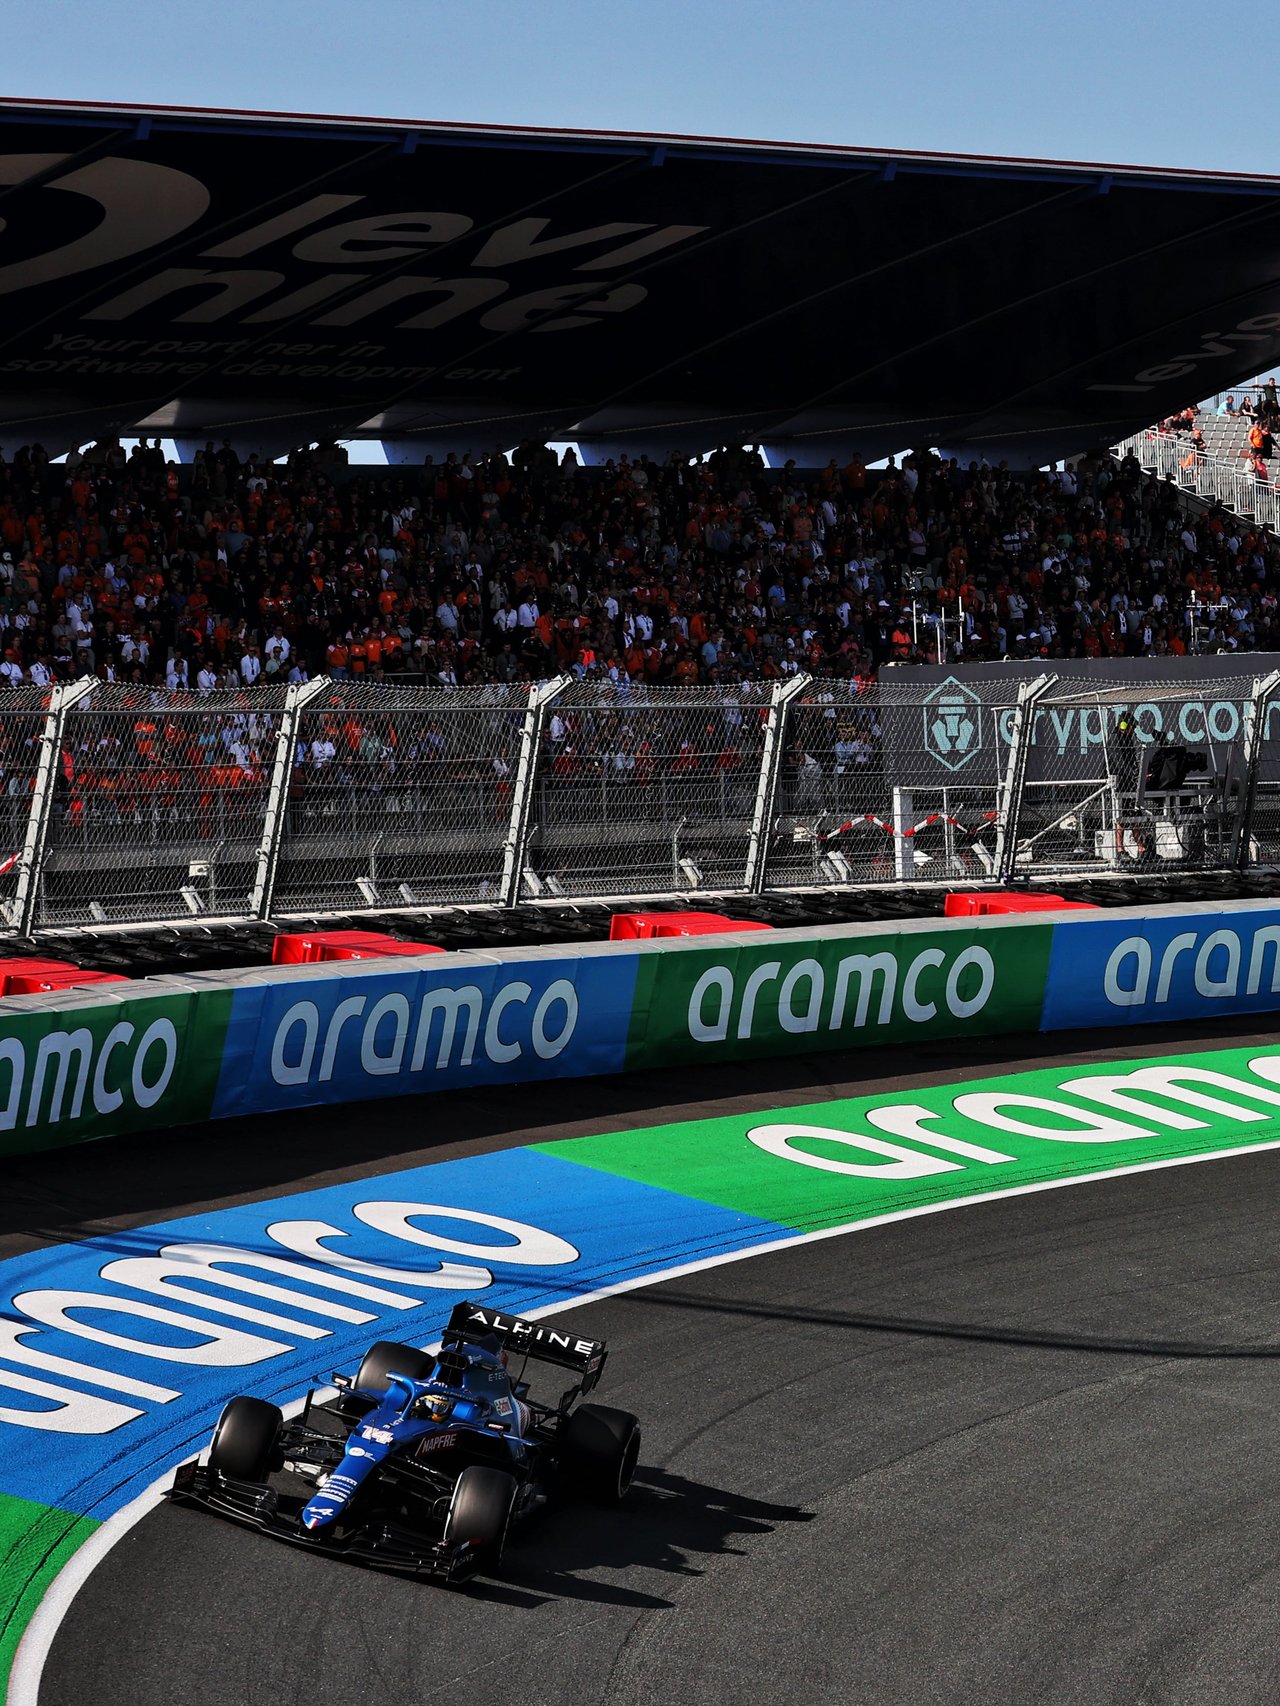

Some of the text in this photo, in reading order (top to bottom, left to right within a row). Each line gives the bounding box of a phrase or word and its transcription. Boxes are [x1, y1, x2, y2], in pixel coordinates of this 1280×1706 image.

[80, 268, 648, 333] nine
[43, 333, 386, 358] Your partner in
[1, 355, 523, 382] software development
[688, 944, 995, 1043] aramco
[271, 978, 579, 1086] aramco
[468, 1310, 594, 1355] ALPINE
[422, 1433, 457, 1454] MAPFRE
